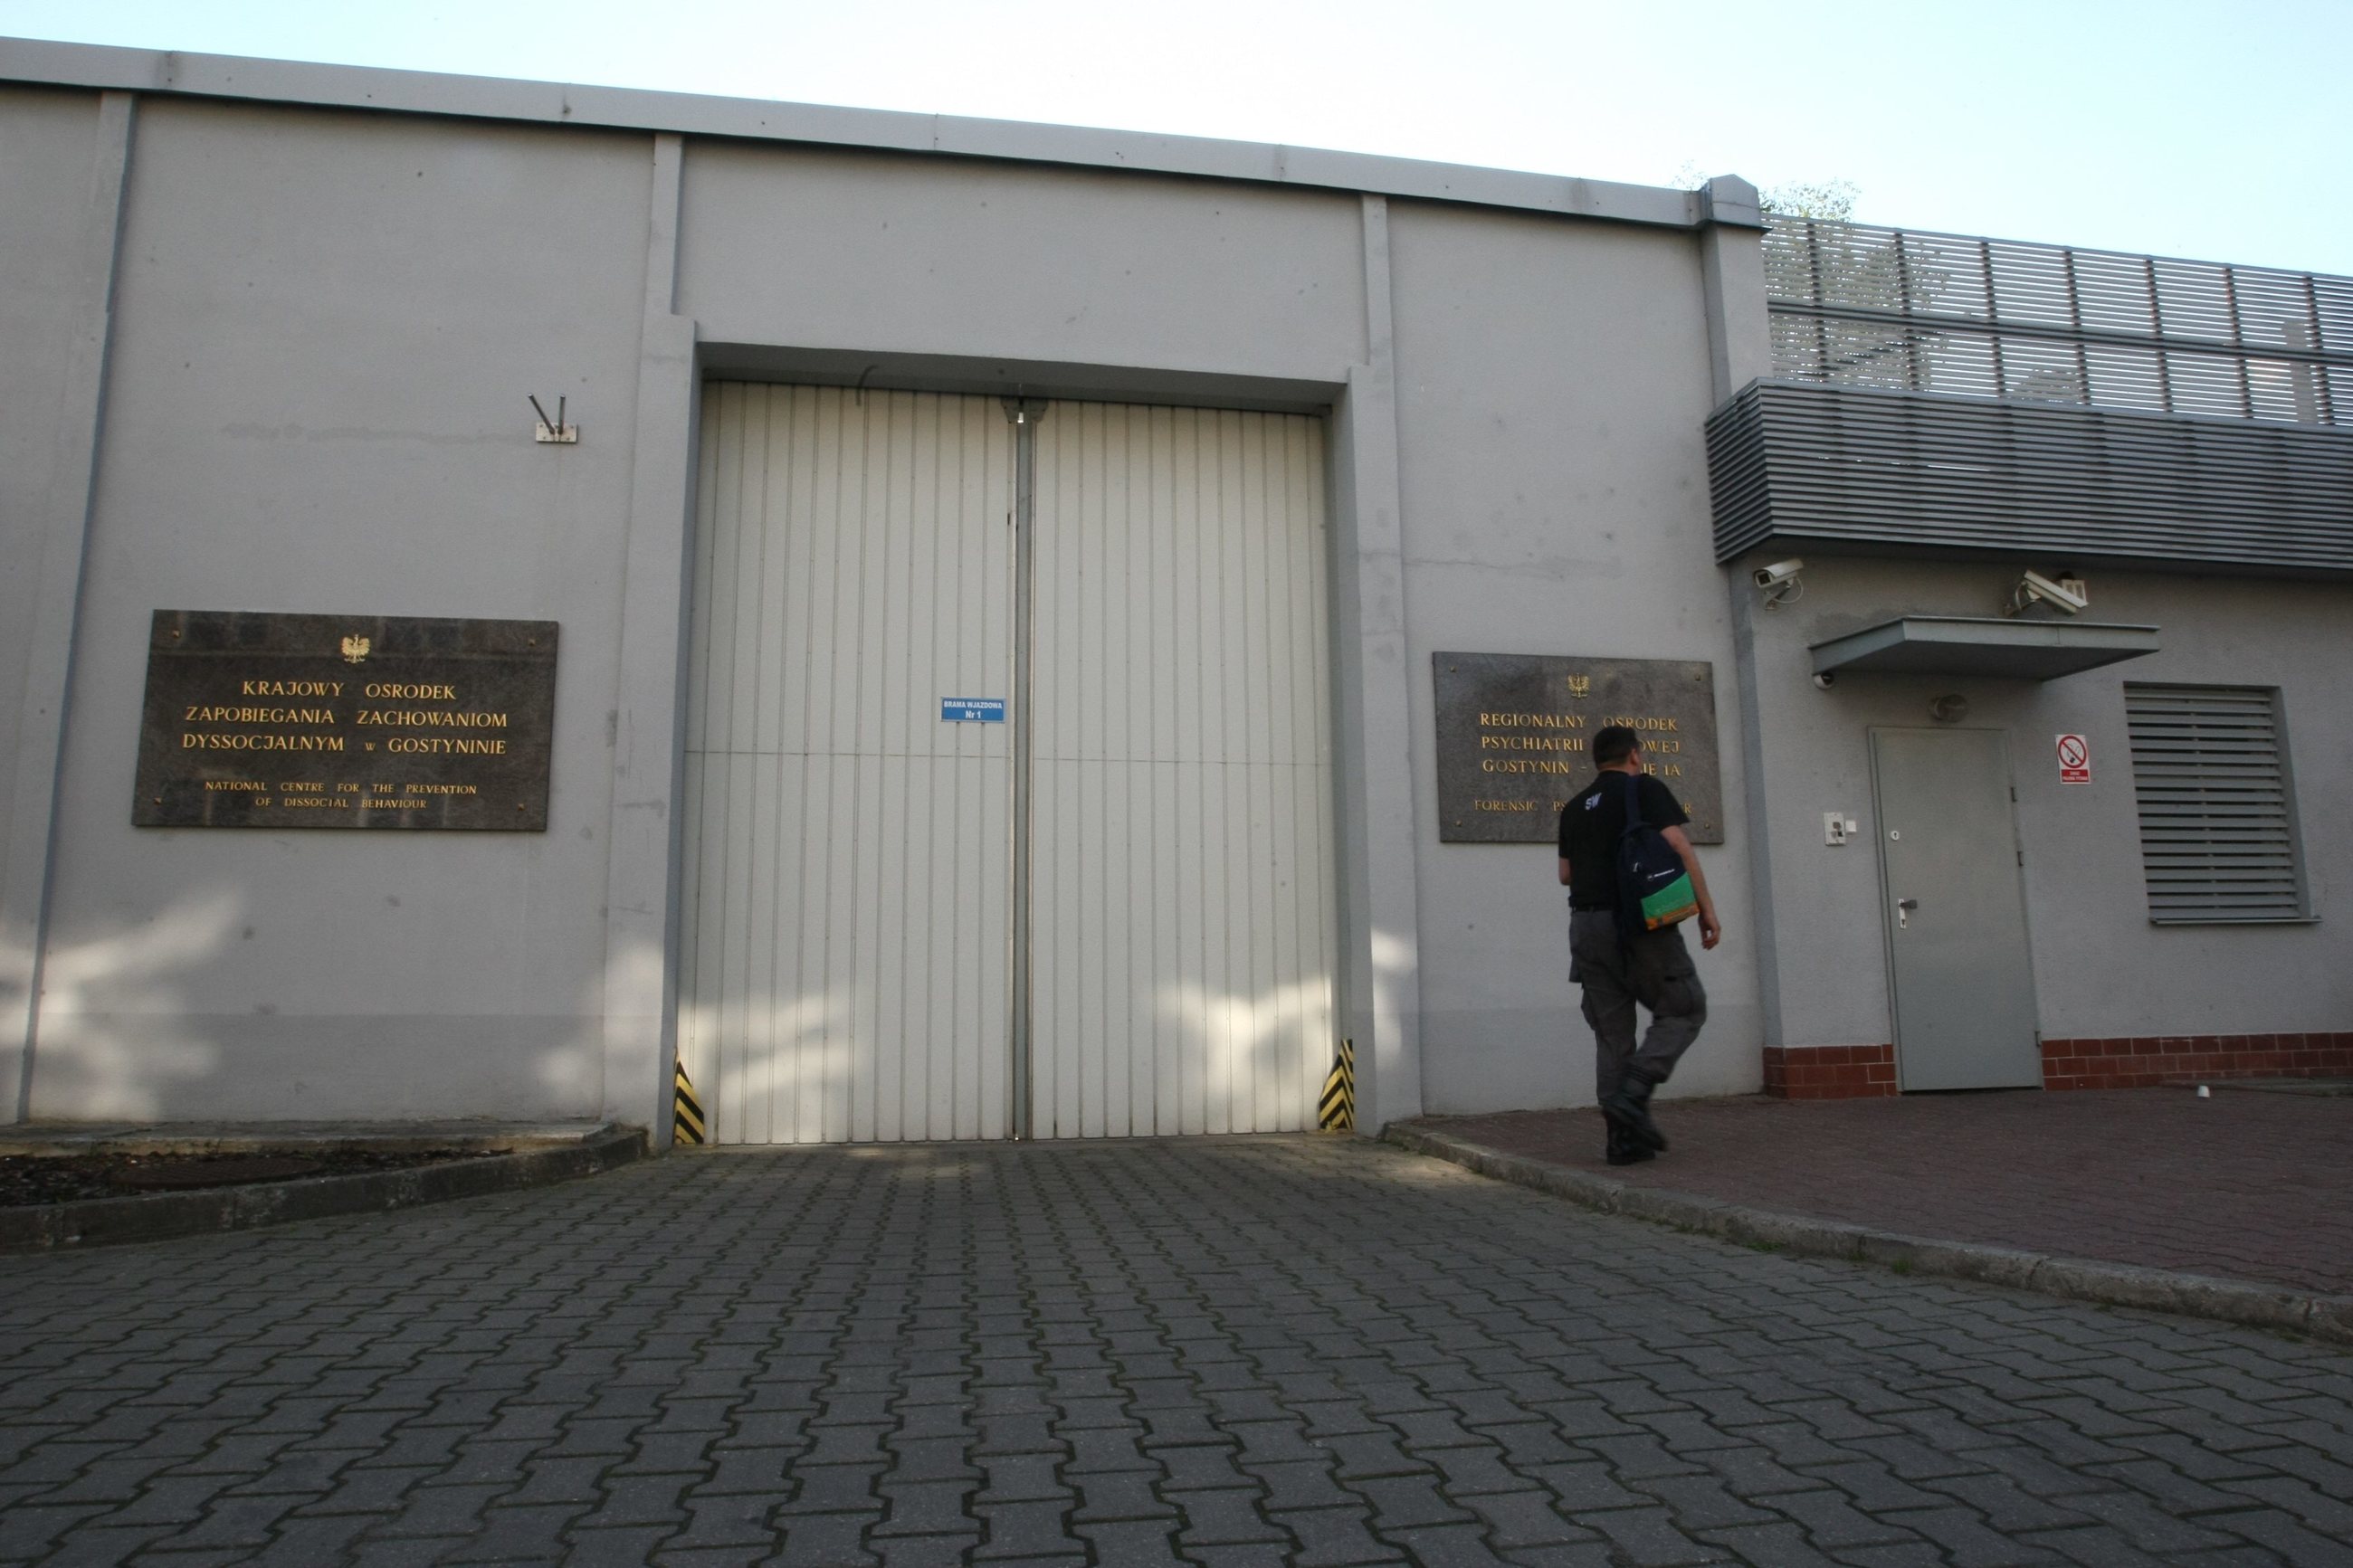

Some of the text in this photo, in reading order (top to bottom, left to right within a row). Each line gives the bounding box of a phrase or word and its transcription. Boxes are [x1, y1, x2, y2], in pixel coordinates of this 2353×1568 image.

[243, 680, 456, 699] KRAJOWY OSRODEK
[185, 707, 507, 727] ZAPOBIEGANIA ZACHOWANIOM
[966, 710, 975, 718] Nr
[1481, 713, 1586, 728] REGIONALNY
[183, 734, 344, 751] DYSSOCJALNYM
[388, 737, 506, 755] GOSTYNINIE
[1481, 736, 1583, 751] PSYCHIATRII
[1482, 760, 1569, 774] GOSTYNIN
[205, 781, 477, 794] NATIONAL CENTRE FOR THE PREVENTION
[255, 797, 427, 809] OF DISSOCIAL BEHAVIOUR
[1475, 800, 1538, 811] FORENSIC
[1585, 793, 1602, 810] SW
